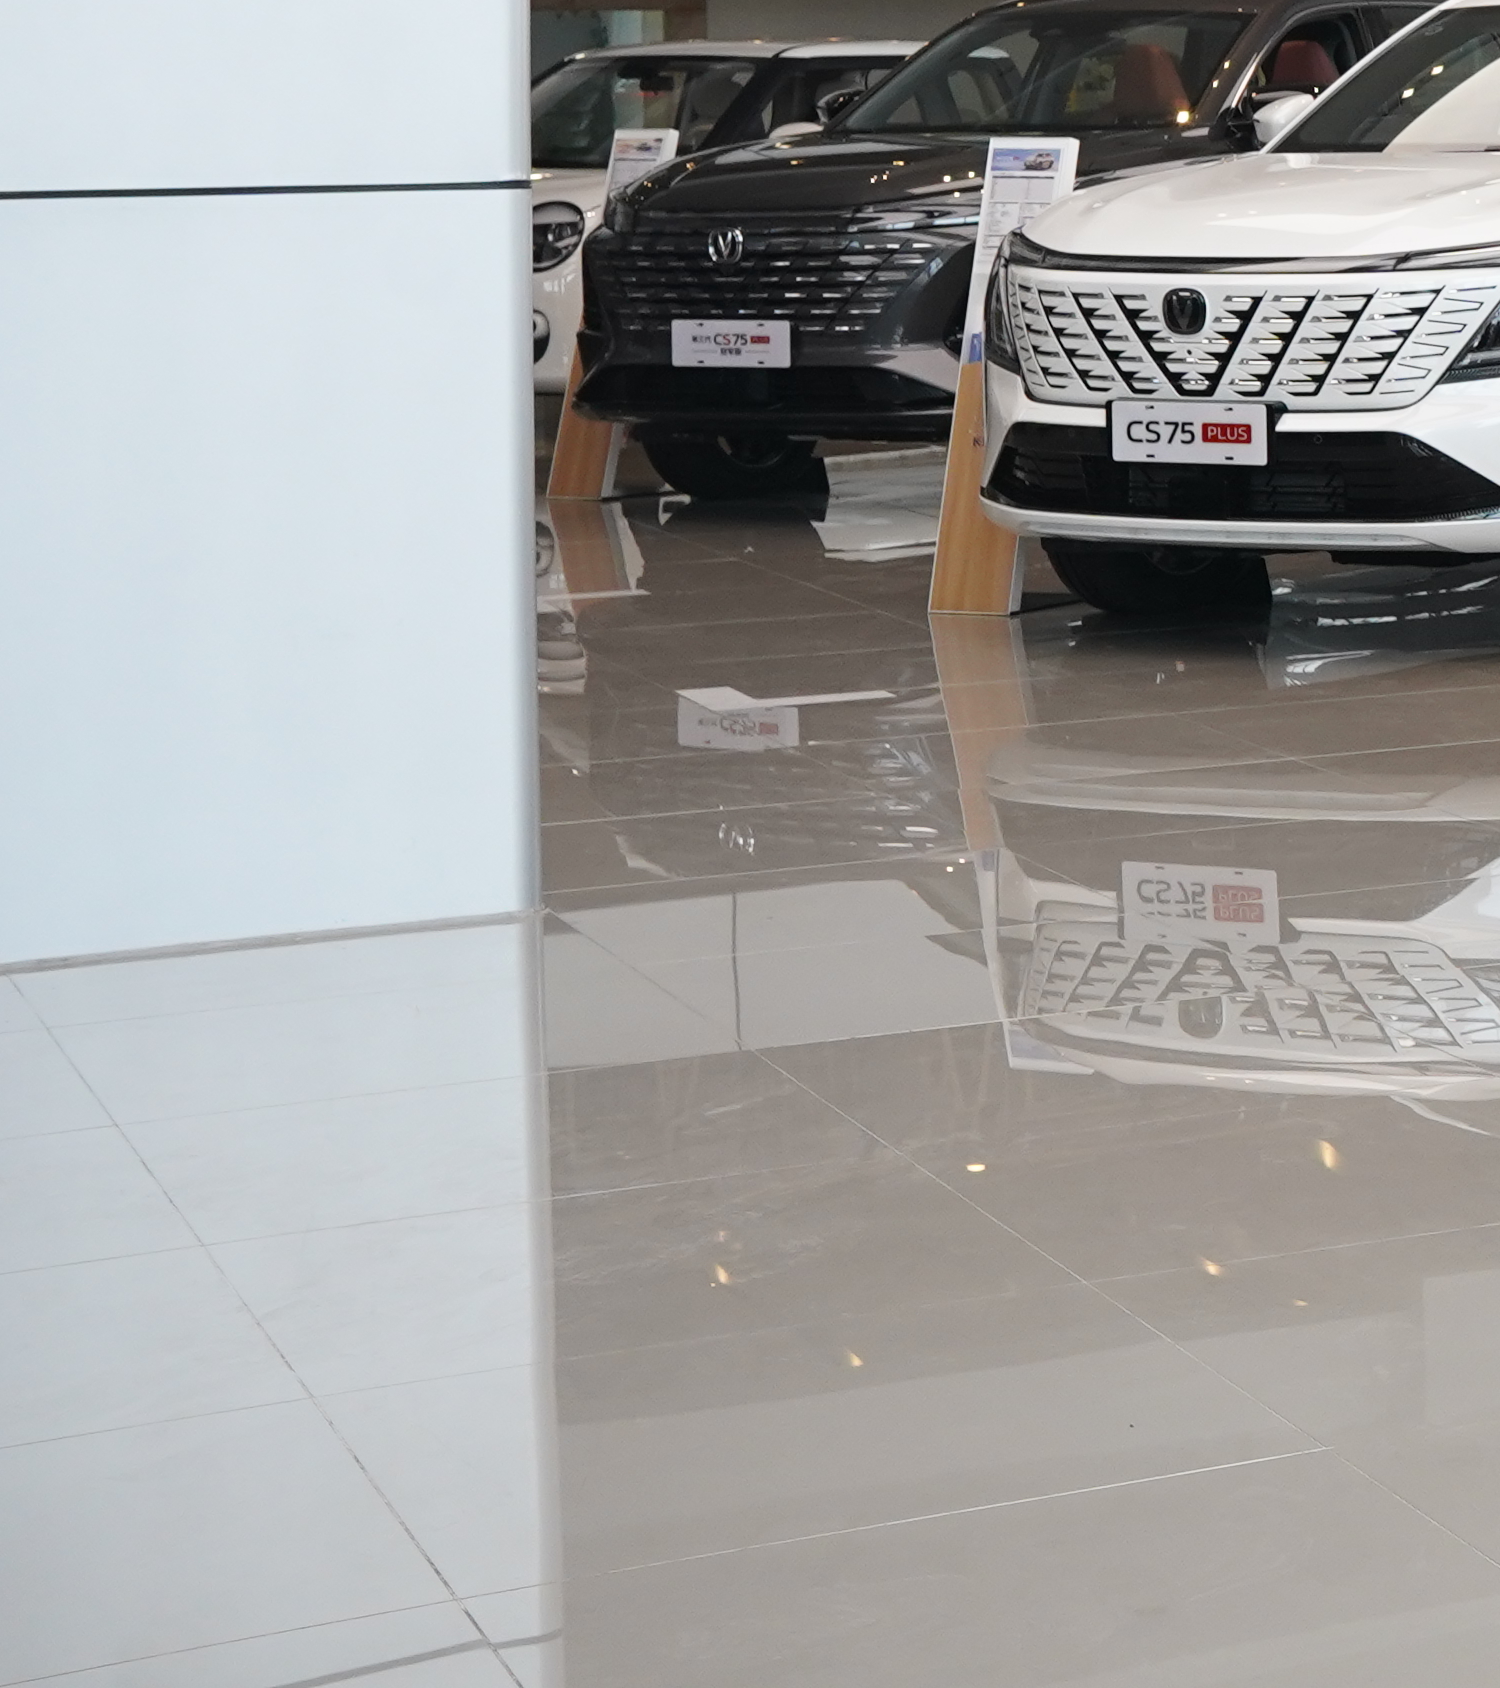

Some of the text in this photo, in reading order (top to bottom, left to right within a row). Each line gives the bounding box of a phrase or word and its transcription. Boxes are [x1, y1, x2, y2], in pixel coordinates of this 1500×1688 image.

[713, 333, 748, 346] CS75
[1126, 420, 1248, 444] CS75 PLUS
